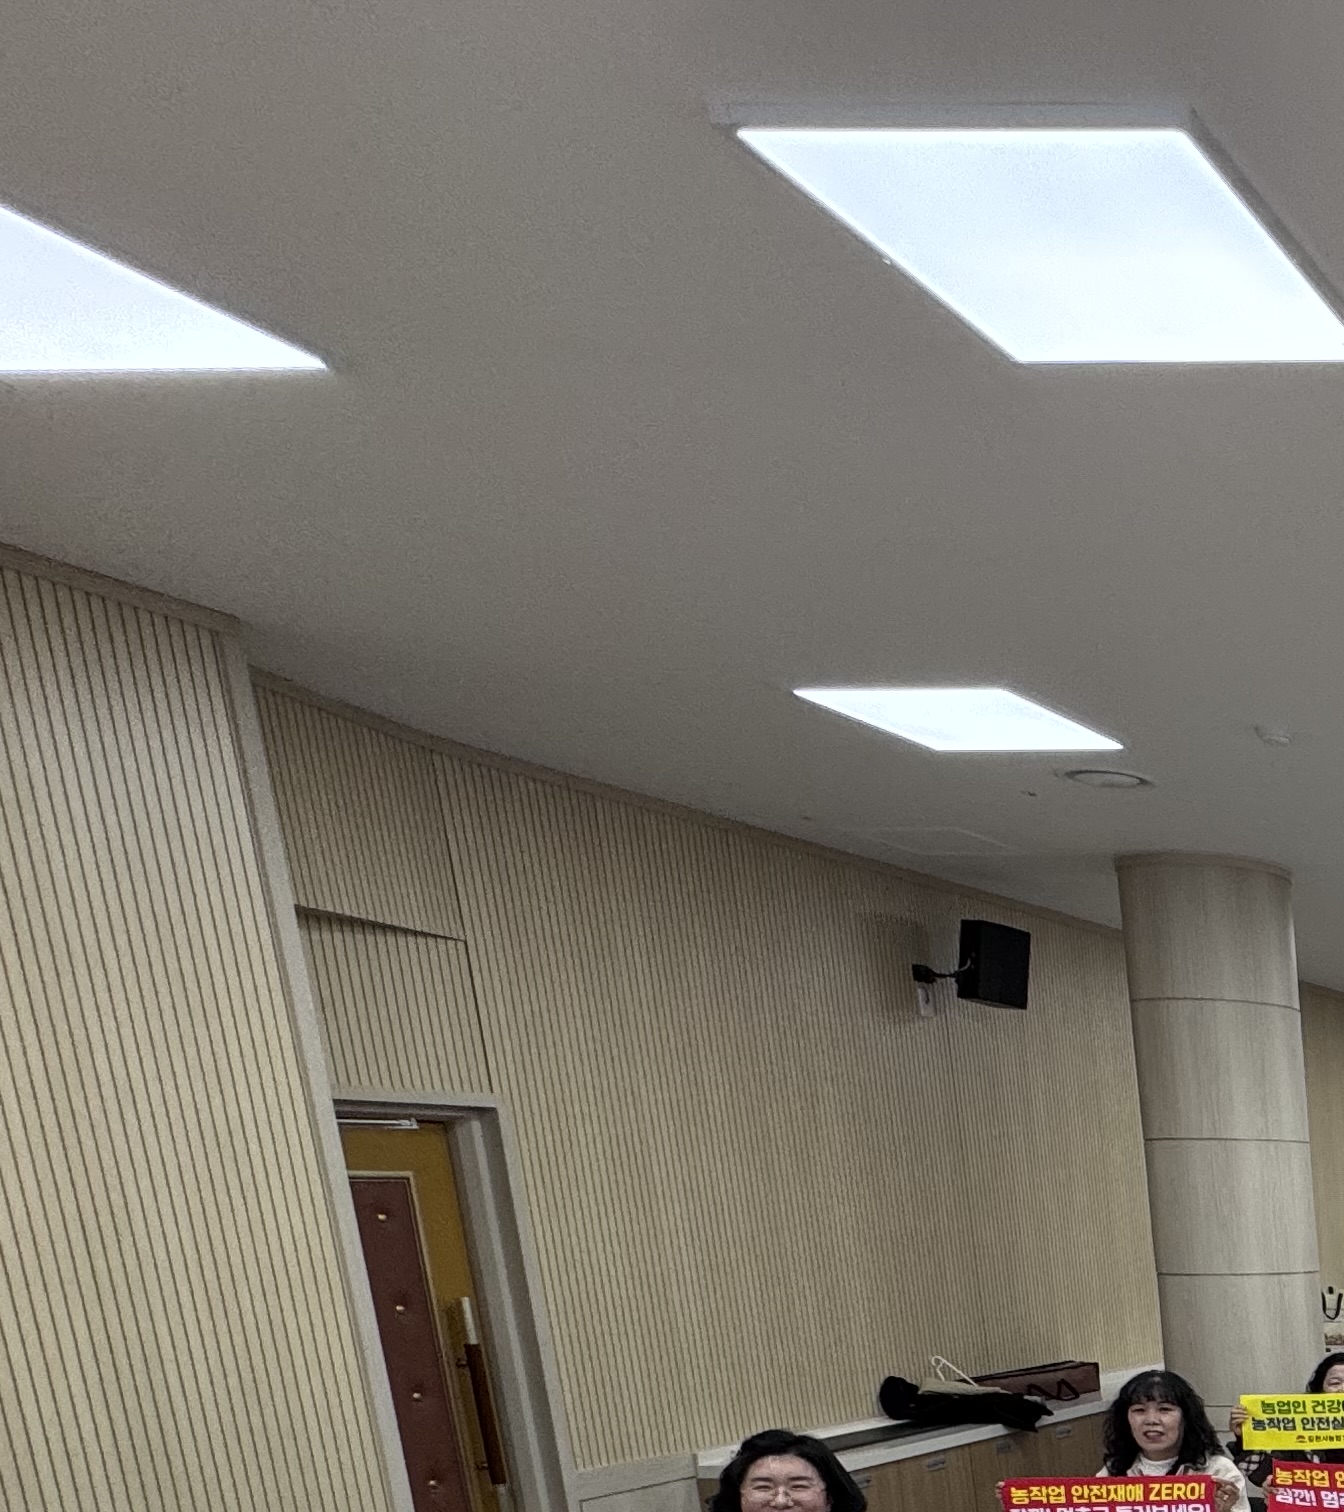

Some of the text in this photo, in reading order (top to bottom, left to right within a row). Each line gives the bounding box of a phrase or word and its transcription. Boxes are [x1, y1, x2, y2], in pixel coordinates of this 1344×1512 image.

[1261, 1399, 1308, 1414] 농업인
[1251, 1416, 1296, 1431] 농작업
[1275, 1468, 1329, 1487] 농작업
[1010, 1483, 1205, 1505] 농작업 안전재해 ZERO!
[1275, 1488, 1317, 1506] 잠깐!
